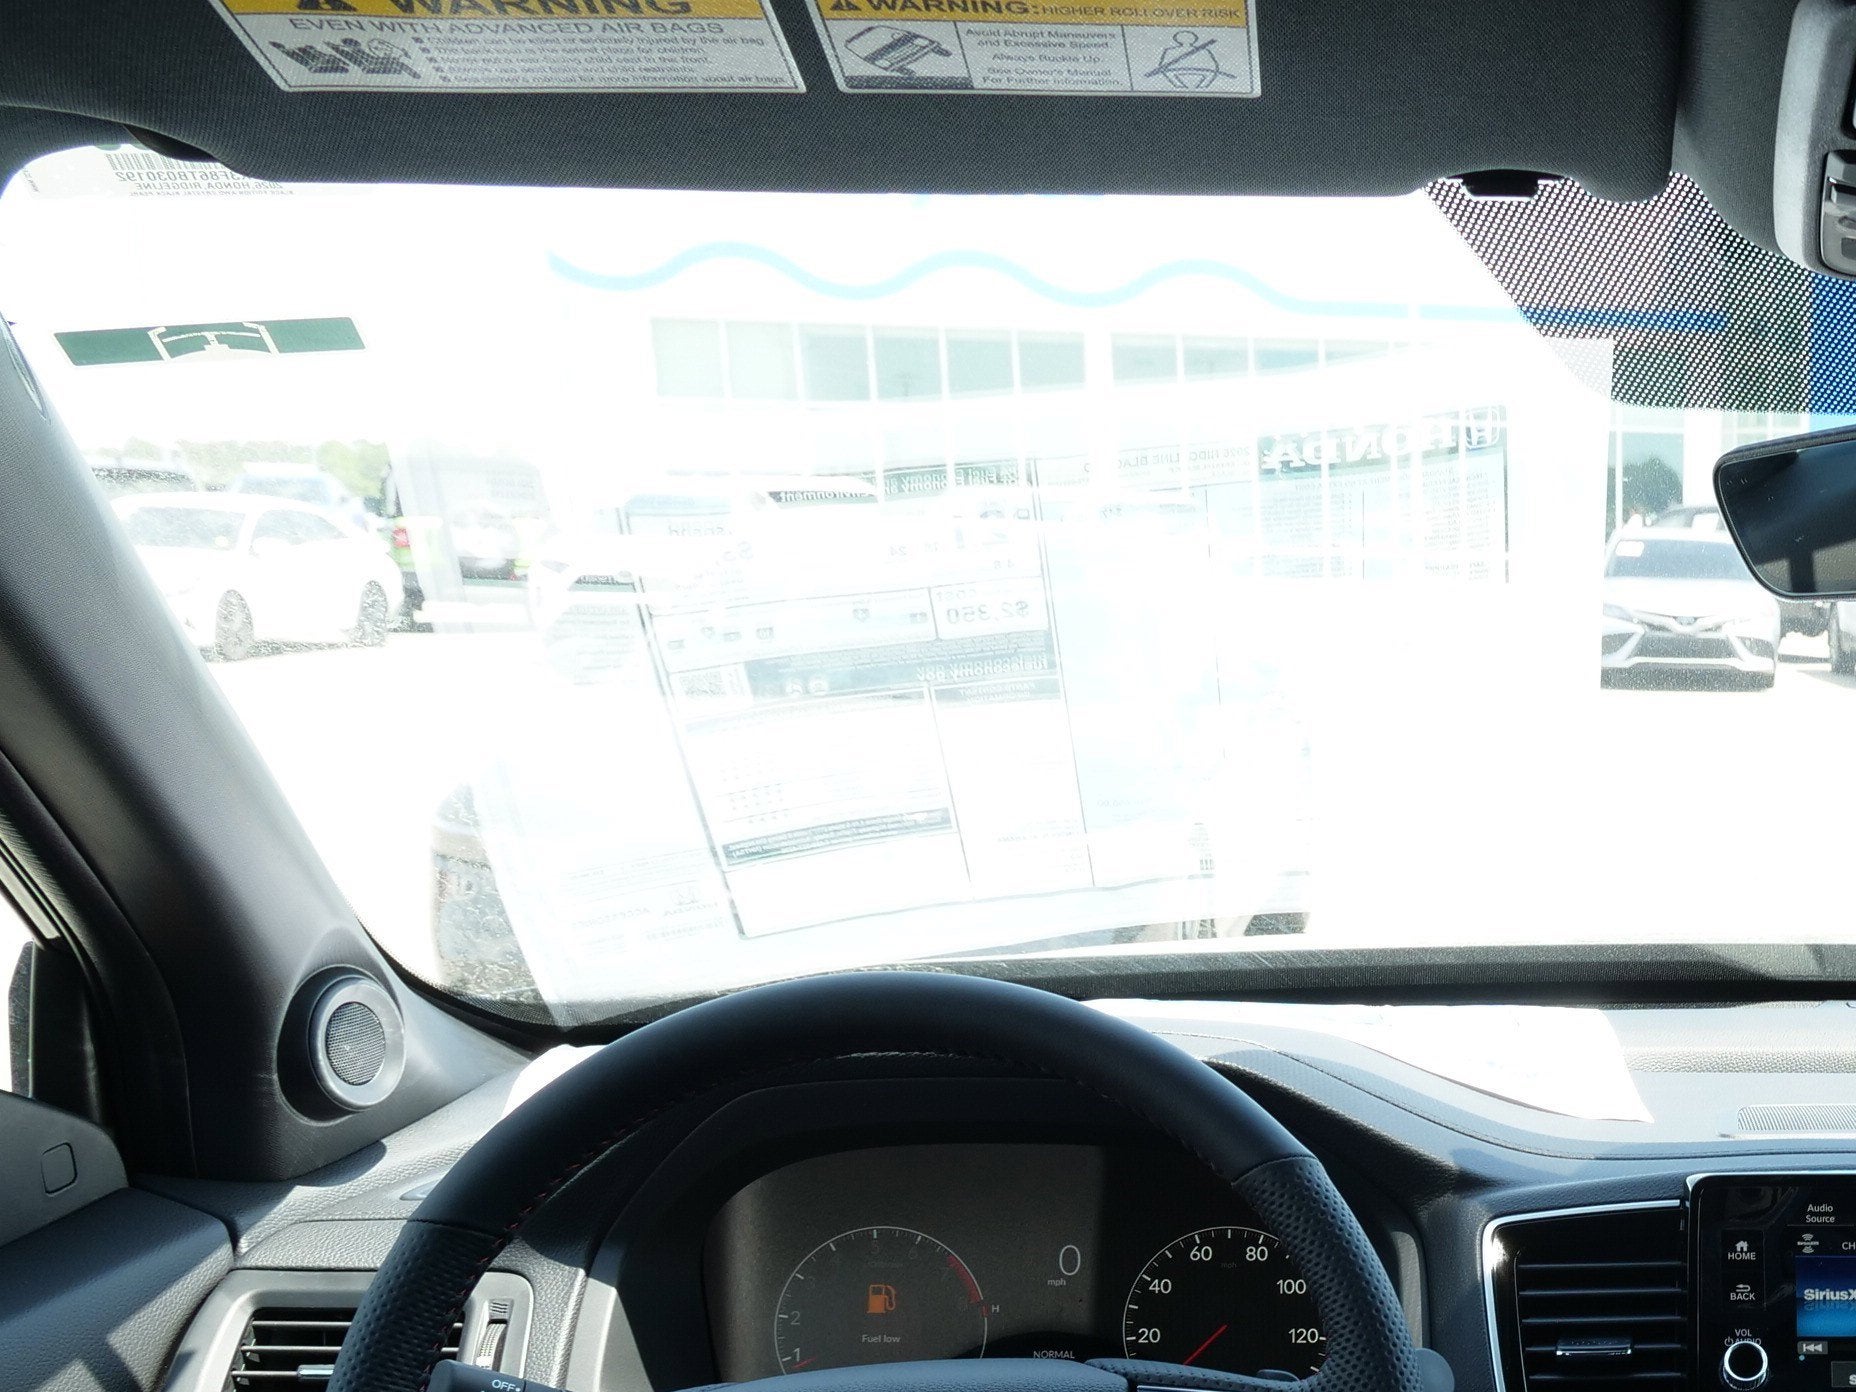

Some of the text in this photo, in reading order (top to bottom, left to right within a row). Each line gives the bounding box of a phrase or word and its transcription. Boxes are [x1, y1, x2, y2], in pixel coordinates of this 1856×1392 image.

[1043, 5, 1106, 16] HIGHER
[1202, 8, 1240, 19] RISK
[289, 18, 725, 34] EVEN WITH ADVANCED AIR BAGS
[1807, 1203, 1834, 1214] Audio
[1805, 1214, 1835, 1223] Source
[1841, 1241, 1856, 1251] CH
[1058, 1244, 1081, 1276] 0
[1189, 1245, 1213, 1262] 60
[1246, 1245, 1269, 1262] 80
[1728, 1252, 1756, 1261] HOME
[1047, 1278, 1067, 1287] mph
[1149, 1278, 1172, 1294] 40
[1276, 1278, 1307, 1295] 100
[1730, 1292, 1755, 1301] BACK
[991, 1305, 1000, 1314] H
[790, 1311, 801, 1326] 2
[862, 1334, 901, 1344] Fuel low
[1138, 1328, 1161, 1343] 20
[1288, 1328, 1319, 1343] 120
[1734, 1328, 1752, 1337] VOL
[793, 1348, 801, 1362] 1
[1033, 1350, 1075, 1360] NORMAL
[491, 1379, 516, 1392] OFF
